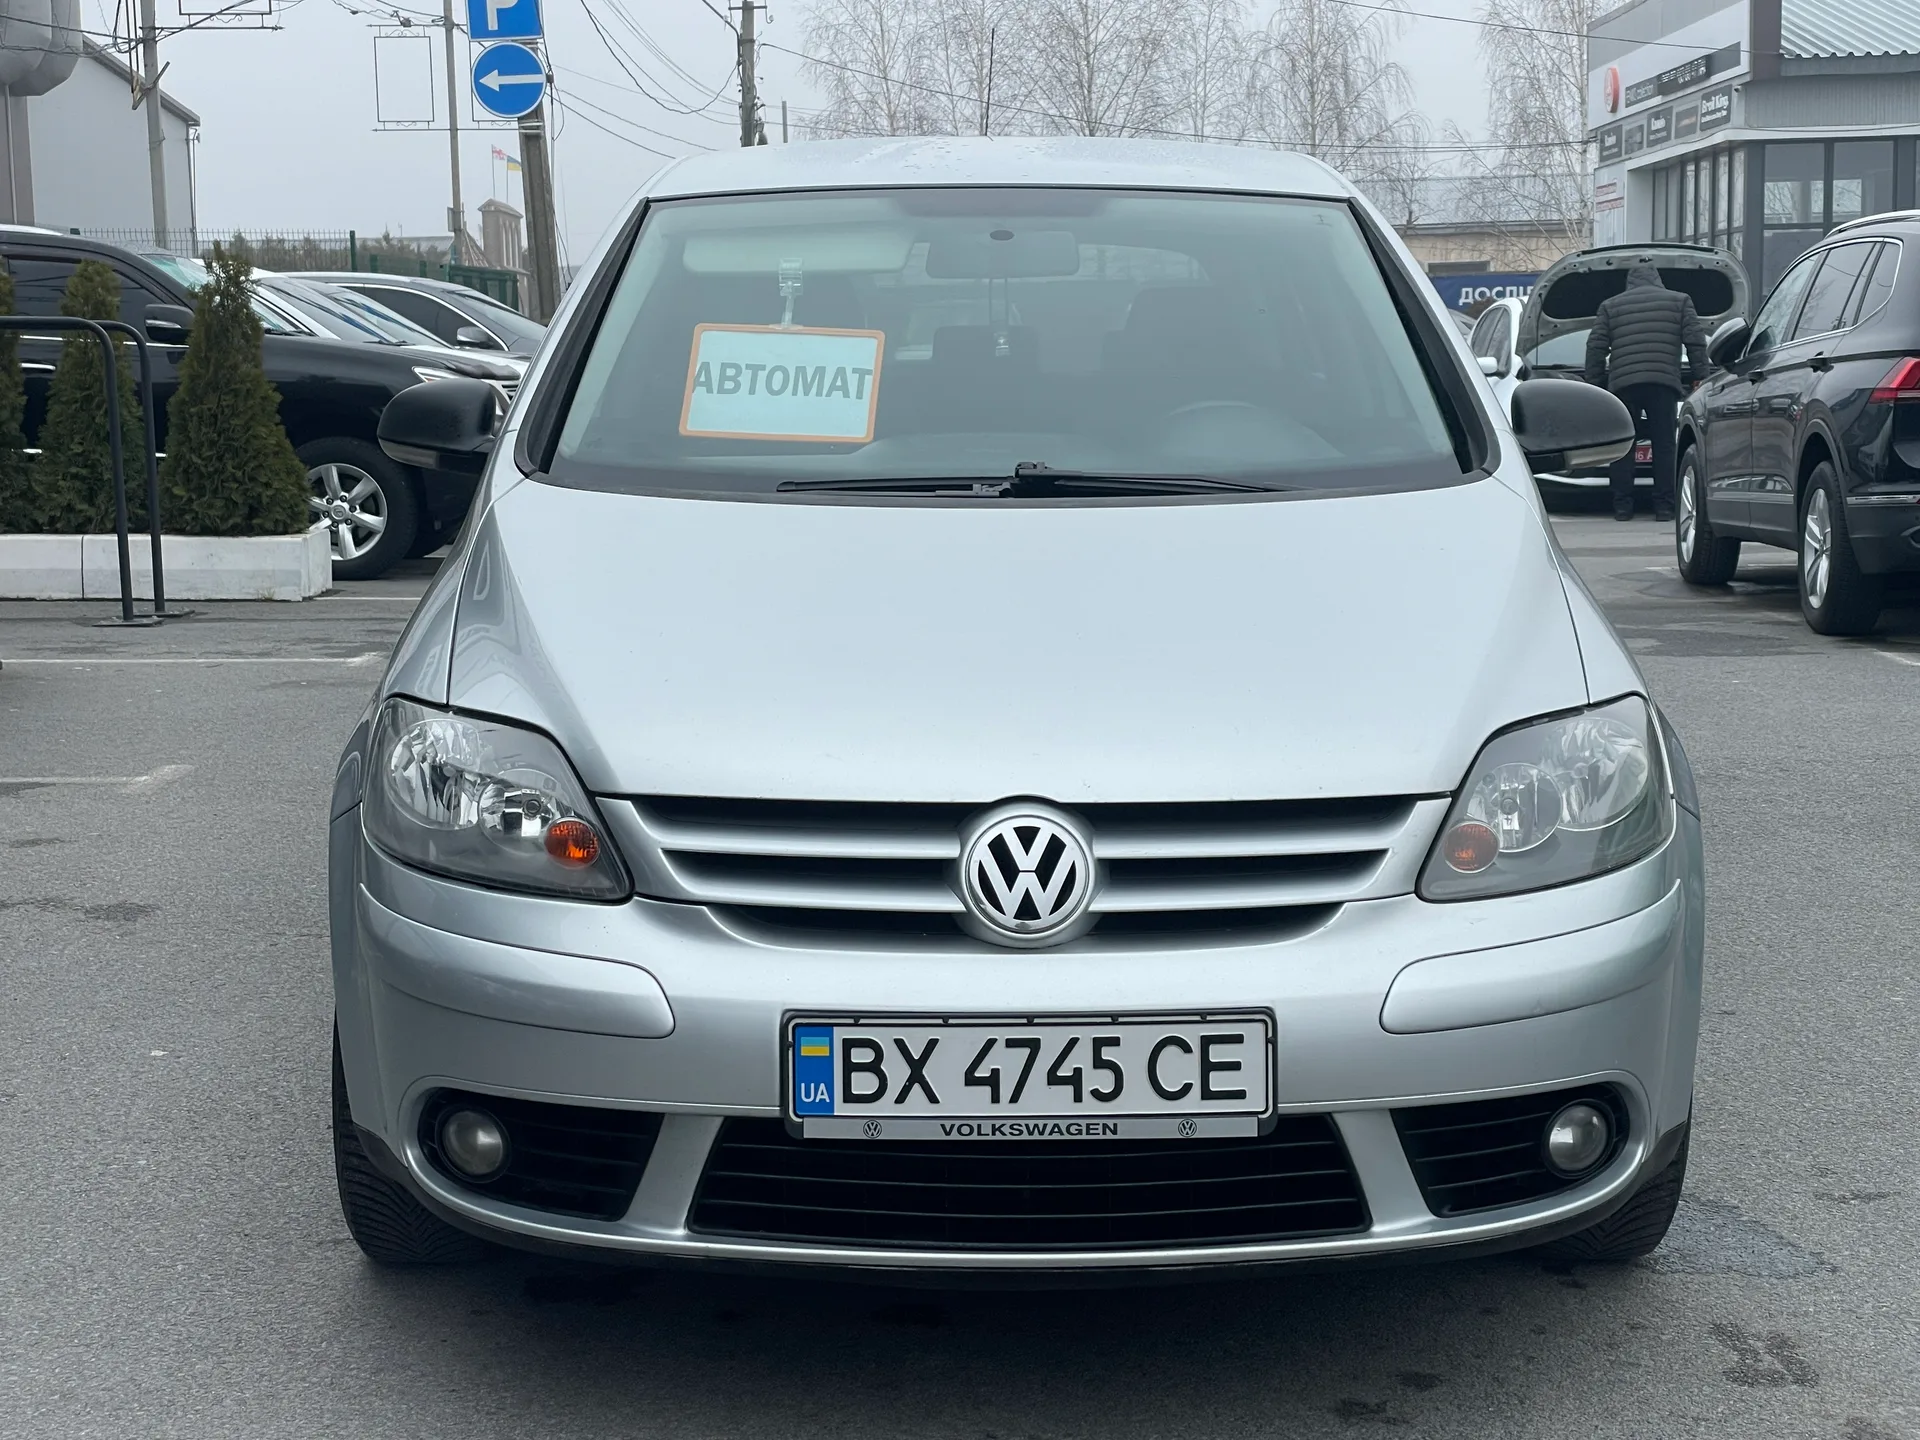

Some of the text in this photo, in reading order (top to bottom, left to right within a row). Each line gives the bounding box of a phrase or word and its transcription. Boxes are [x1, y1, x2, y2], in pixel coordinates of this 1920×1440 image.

[692, 361, 873, 400] АВТОМАТ
[842, 1033, 1247, 1104] BX 4745 CE
[801, 1083, 830, 1103] UA
[940, 1122, 1118, 1137] VOLKSWAGEN
